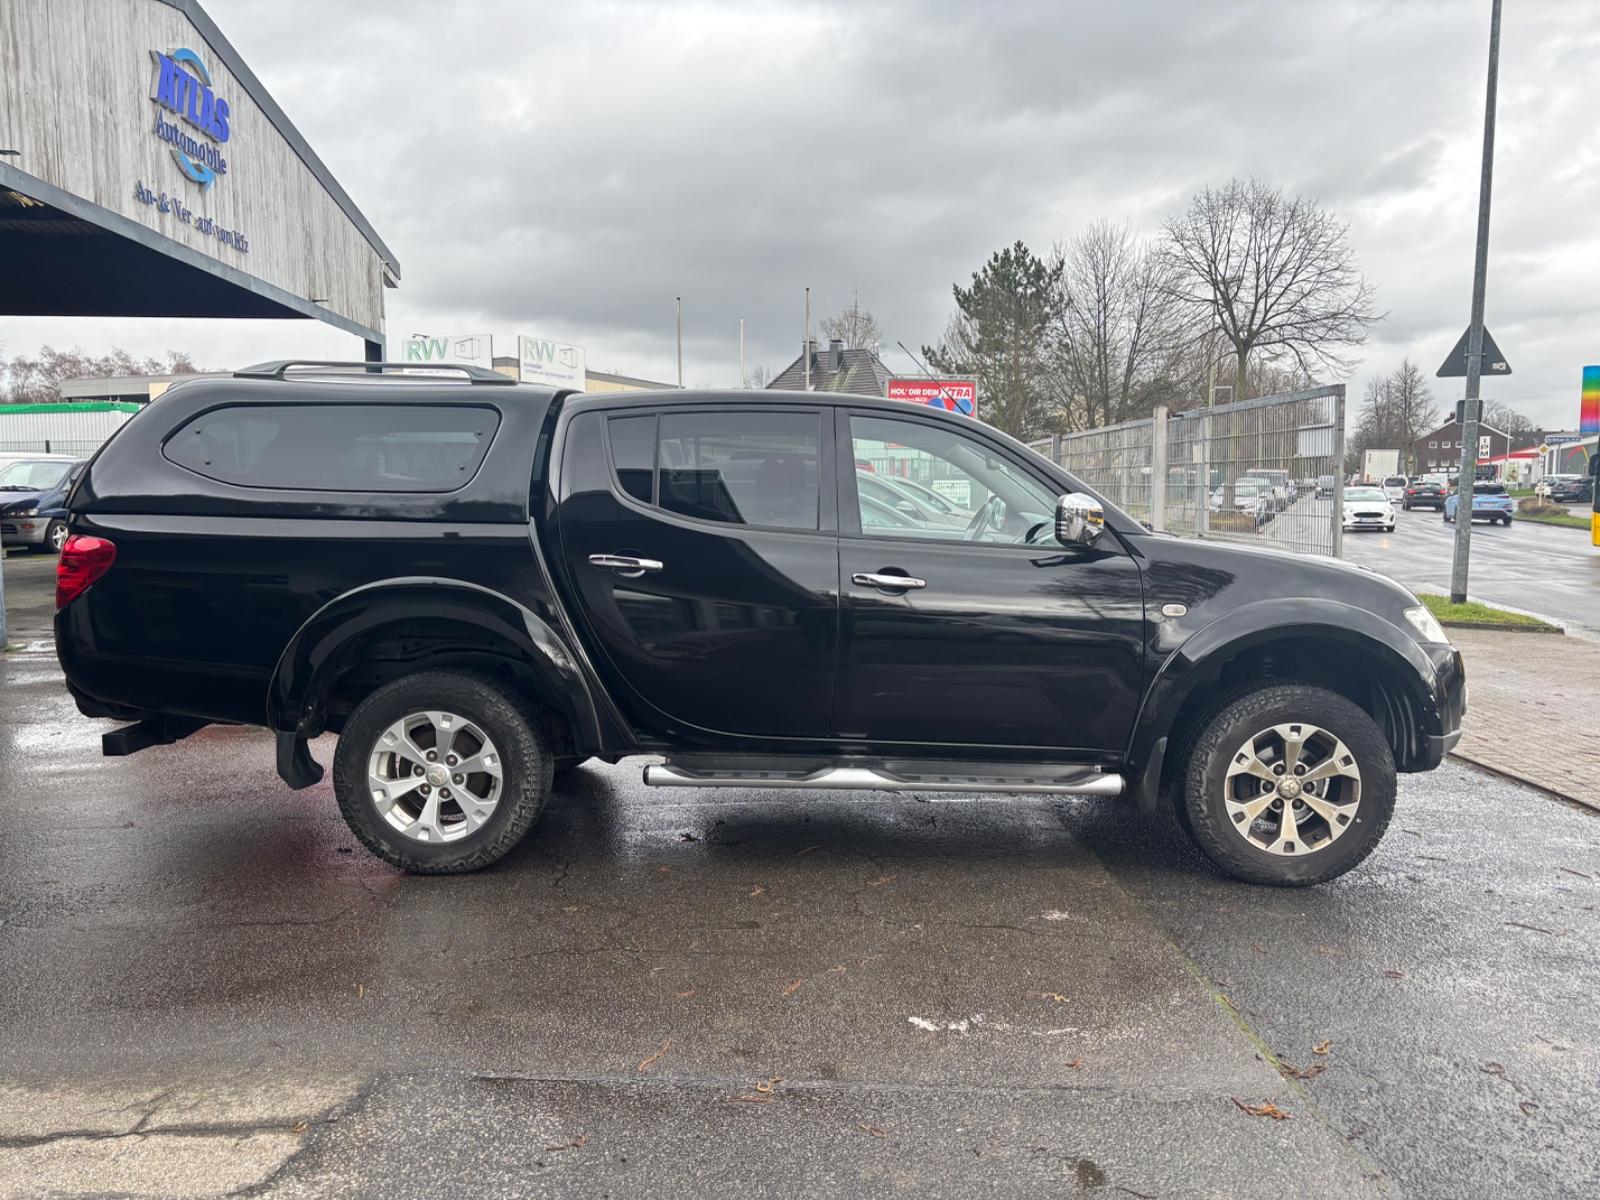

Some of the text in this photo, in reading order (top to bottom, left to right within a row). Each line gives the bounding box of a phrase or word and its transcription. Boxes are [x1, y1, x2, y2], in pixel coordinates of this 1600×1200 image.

[154, 50, 230, 143] ATLAS
[156, 110, 227, 175] Automobile
[136, 180, 158, 206] An-
[158, 192, 170, 213] &
[908, 387, 921, 396] DIR
[922, 387, 939, 396] DEIN
